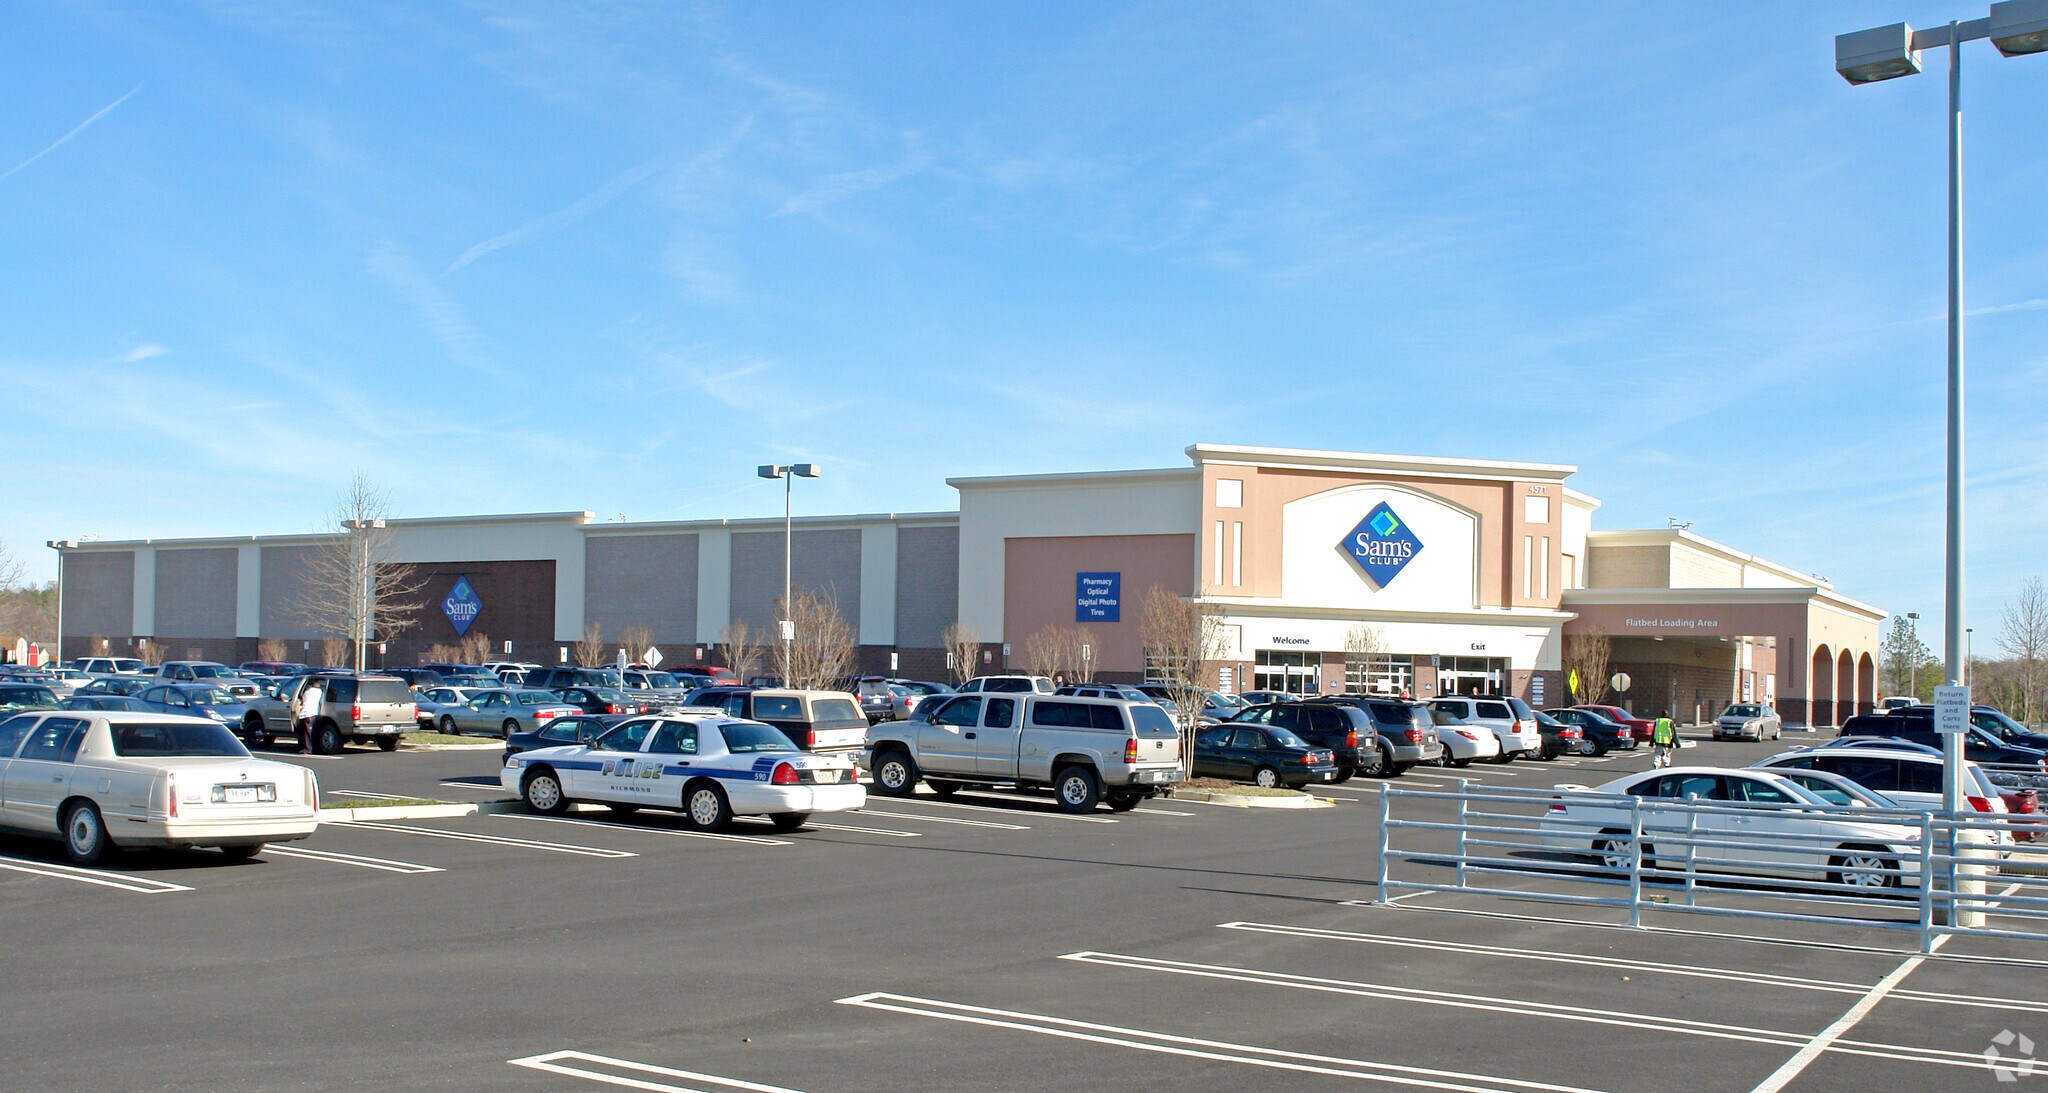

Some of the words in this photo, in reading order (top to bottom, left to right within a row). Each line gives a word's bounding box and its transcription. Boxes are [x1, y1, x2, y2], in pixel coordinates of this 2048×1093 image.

[1355, 532, 1412, 558] Sam's
[1369, 556, 1399, 565] CLUB
[1083, 578, 1112, 586] Pharmacy
[1087, 588, 1109, 596] Optical
[446, 597, 477, 615] Sam's
[1078, 598, 1098, 607] Digital
[1099, 598, 1117, 606] Photo
[1091, 608, 1105, 616] Tires
[1625, 618, 1658, 627] Flatbed
[1659, 618, 1695, 629] Loading
[1697, 618, 1718, 627] Area
[1272, 636, 1310, 645] Welcome
[1471, 642, 1486, 651] Exit
[602, 759, 664, 780] POLICE
[754, 772, 767, 781] 590
[610, 784, 652, 793] RICHMOND
